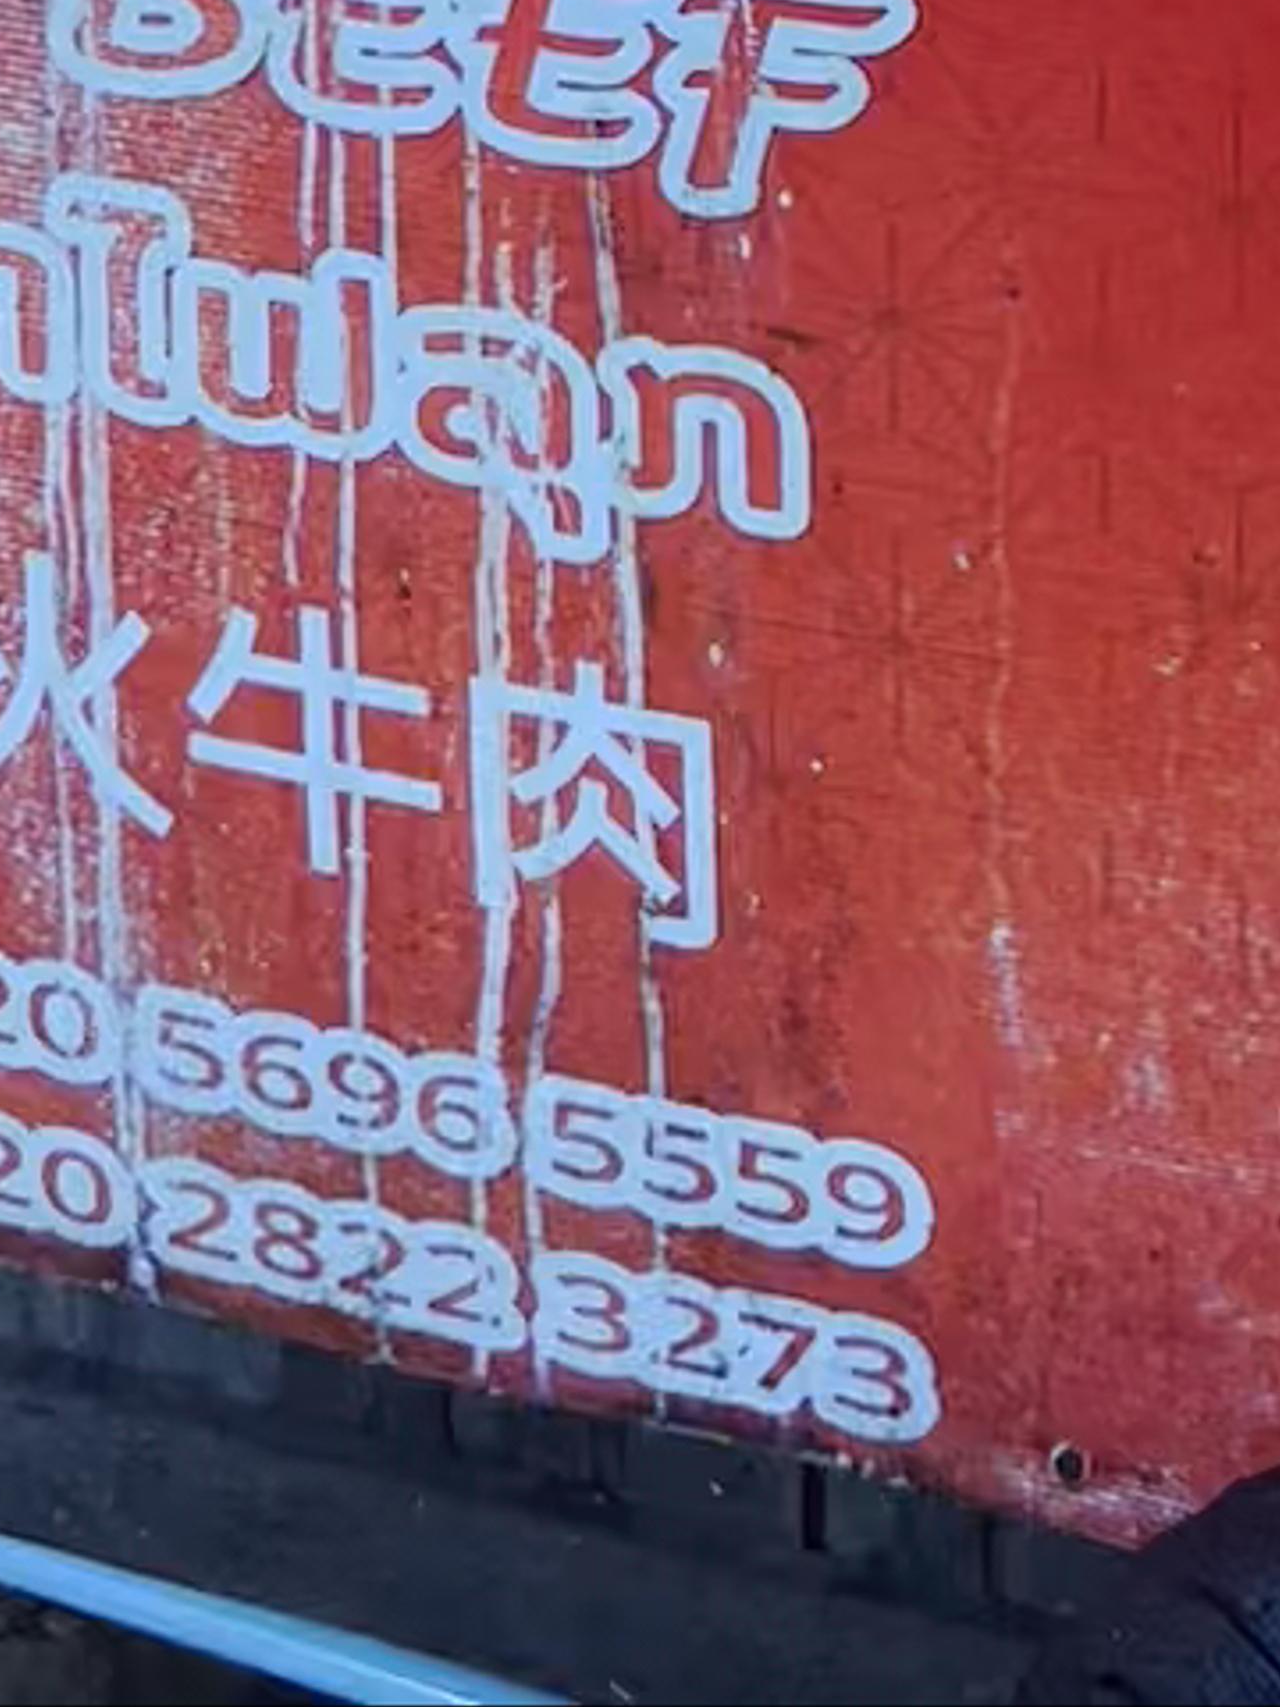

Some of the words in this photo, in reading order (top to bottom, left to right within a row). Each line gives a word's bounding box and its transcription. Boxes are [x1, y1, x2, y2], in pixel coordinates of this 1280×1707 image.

[144, 994, 501, 1165] 5696
[540, 1087, 920, 1255] 5559
[156, 1170, 508, 1338] 2822
[545, 1262, 927, 1429] 3273
